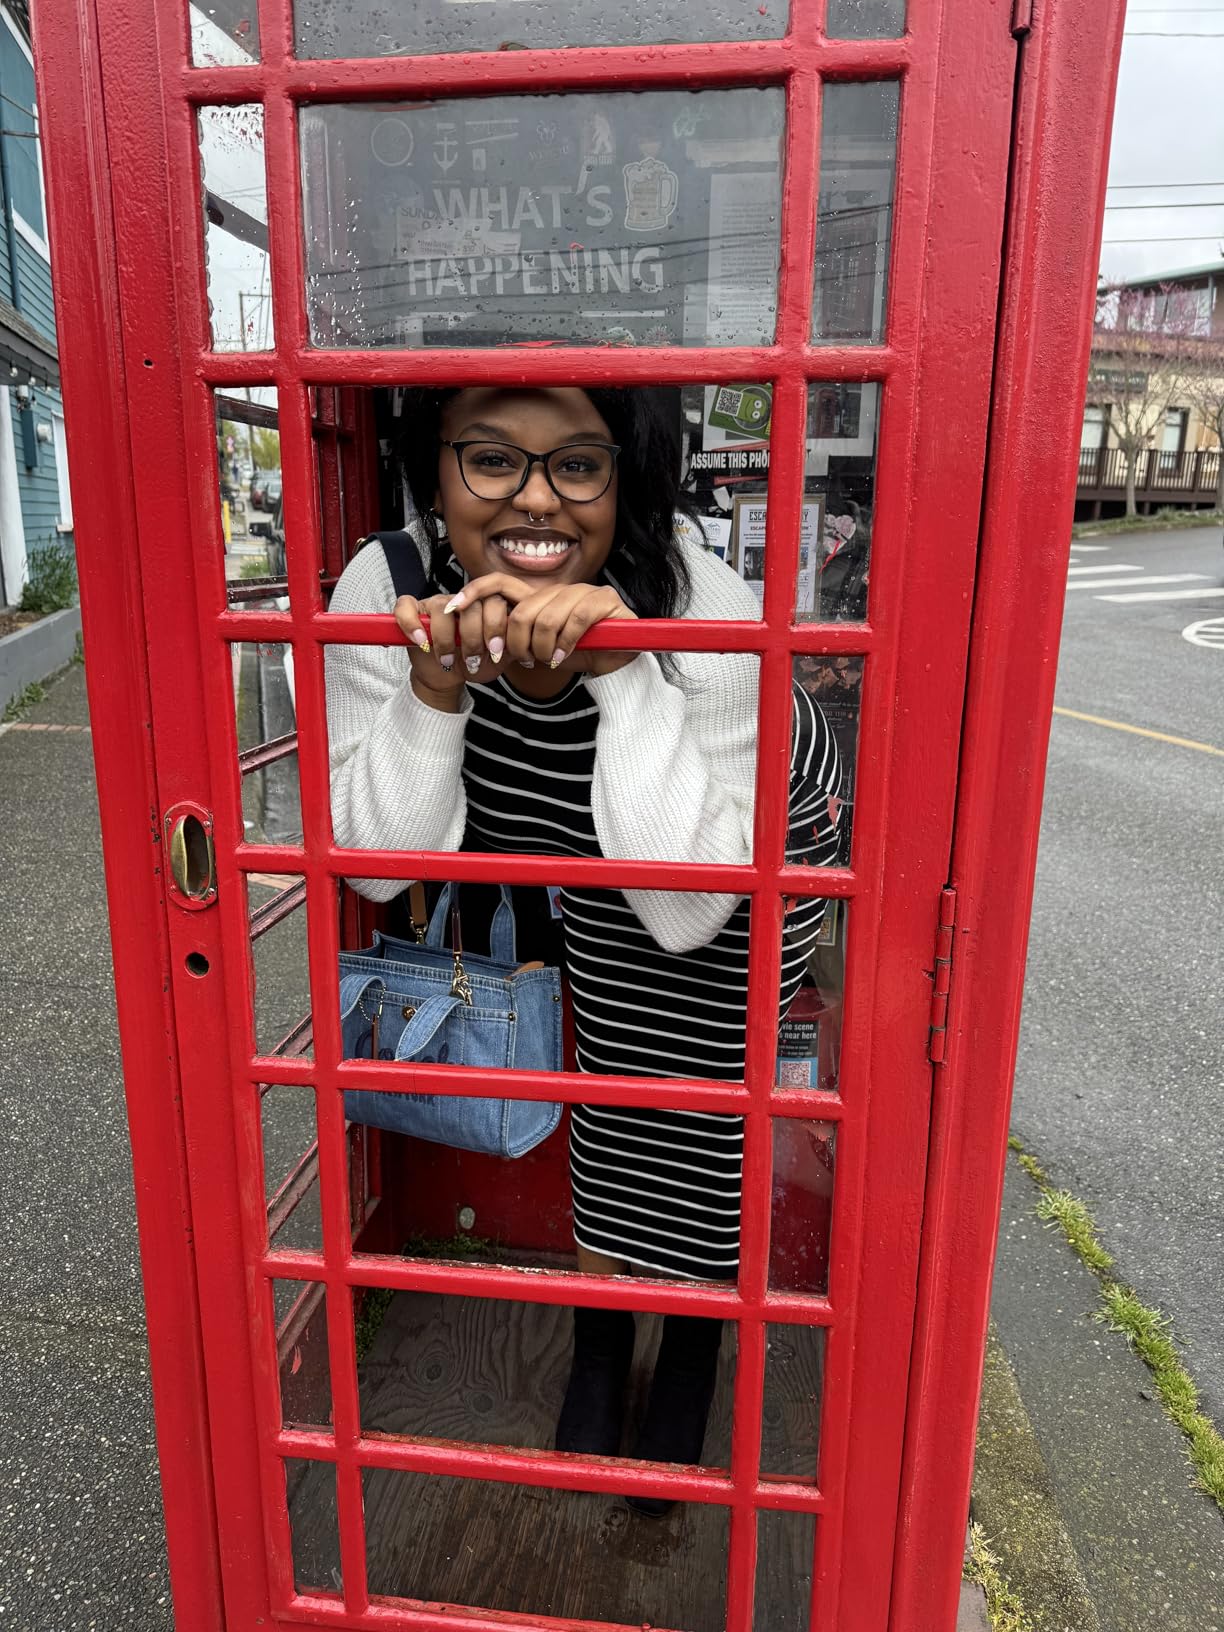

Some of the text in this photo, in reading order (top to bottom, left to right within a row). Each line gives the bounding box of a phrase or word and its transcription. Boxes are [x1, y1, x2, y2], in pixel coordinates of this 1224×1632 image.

[432, 164, 613, 230] WHAT'S
[407, 246, 664, 297] HAPPENING
[691, 450, 770, 469] ASSUME THIS PHO
